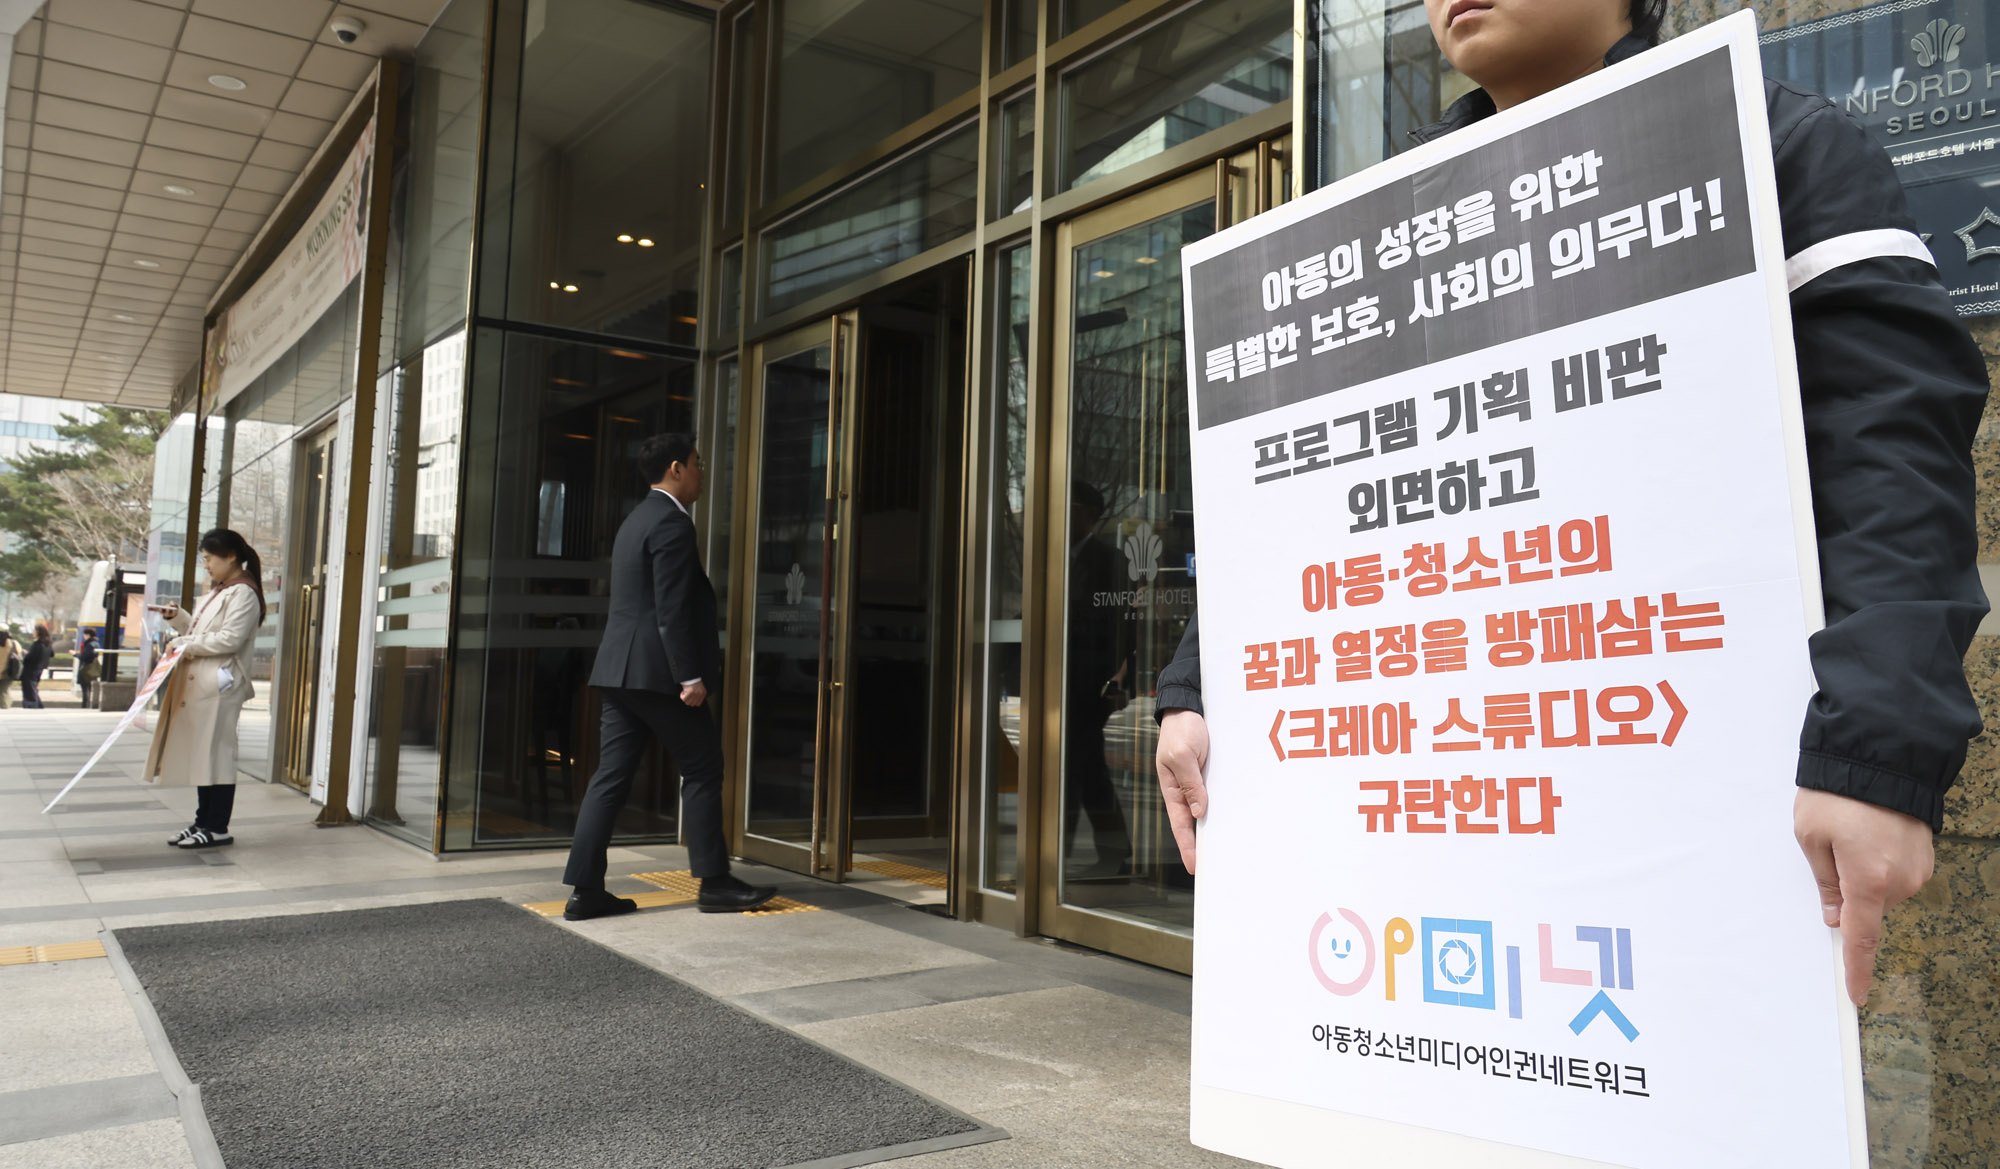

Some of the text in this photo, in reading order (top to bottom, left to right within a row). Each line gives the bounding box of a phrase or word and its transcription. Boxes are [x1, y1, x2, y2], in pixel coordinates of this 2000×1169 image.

[1829, 68, 1972, 114] NFORD
[1886, 98, 1997, 135] SEOUL
[1969, 138, 1995, 152] 서울
[1262, 149, 1603, 312] 아동의 성장을 위한
[1205, 177, 1726, 383] 특별한 보호, 사회의 의무다!
[1970, 281, 1999, 294] Hotel
[1254, 333, 1668, 485] 프로그램 기획 비판
[1347, 446, 1541, 534] 외면하고
[1156, 589, 1195, 605] HOTEL
[1302, 514, 1613, 613] 아동·청소년의
[1124, 612, 1160, 621] SEOL
[1243, 592, 1725, 691] 꿈과 열정을 방패삼는
[1358, 775, 1563, 835] 규탄한다
[1312, 1023, 1651, 1098] 아동청소년미디어인권네트워크
